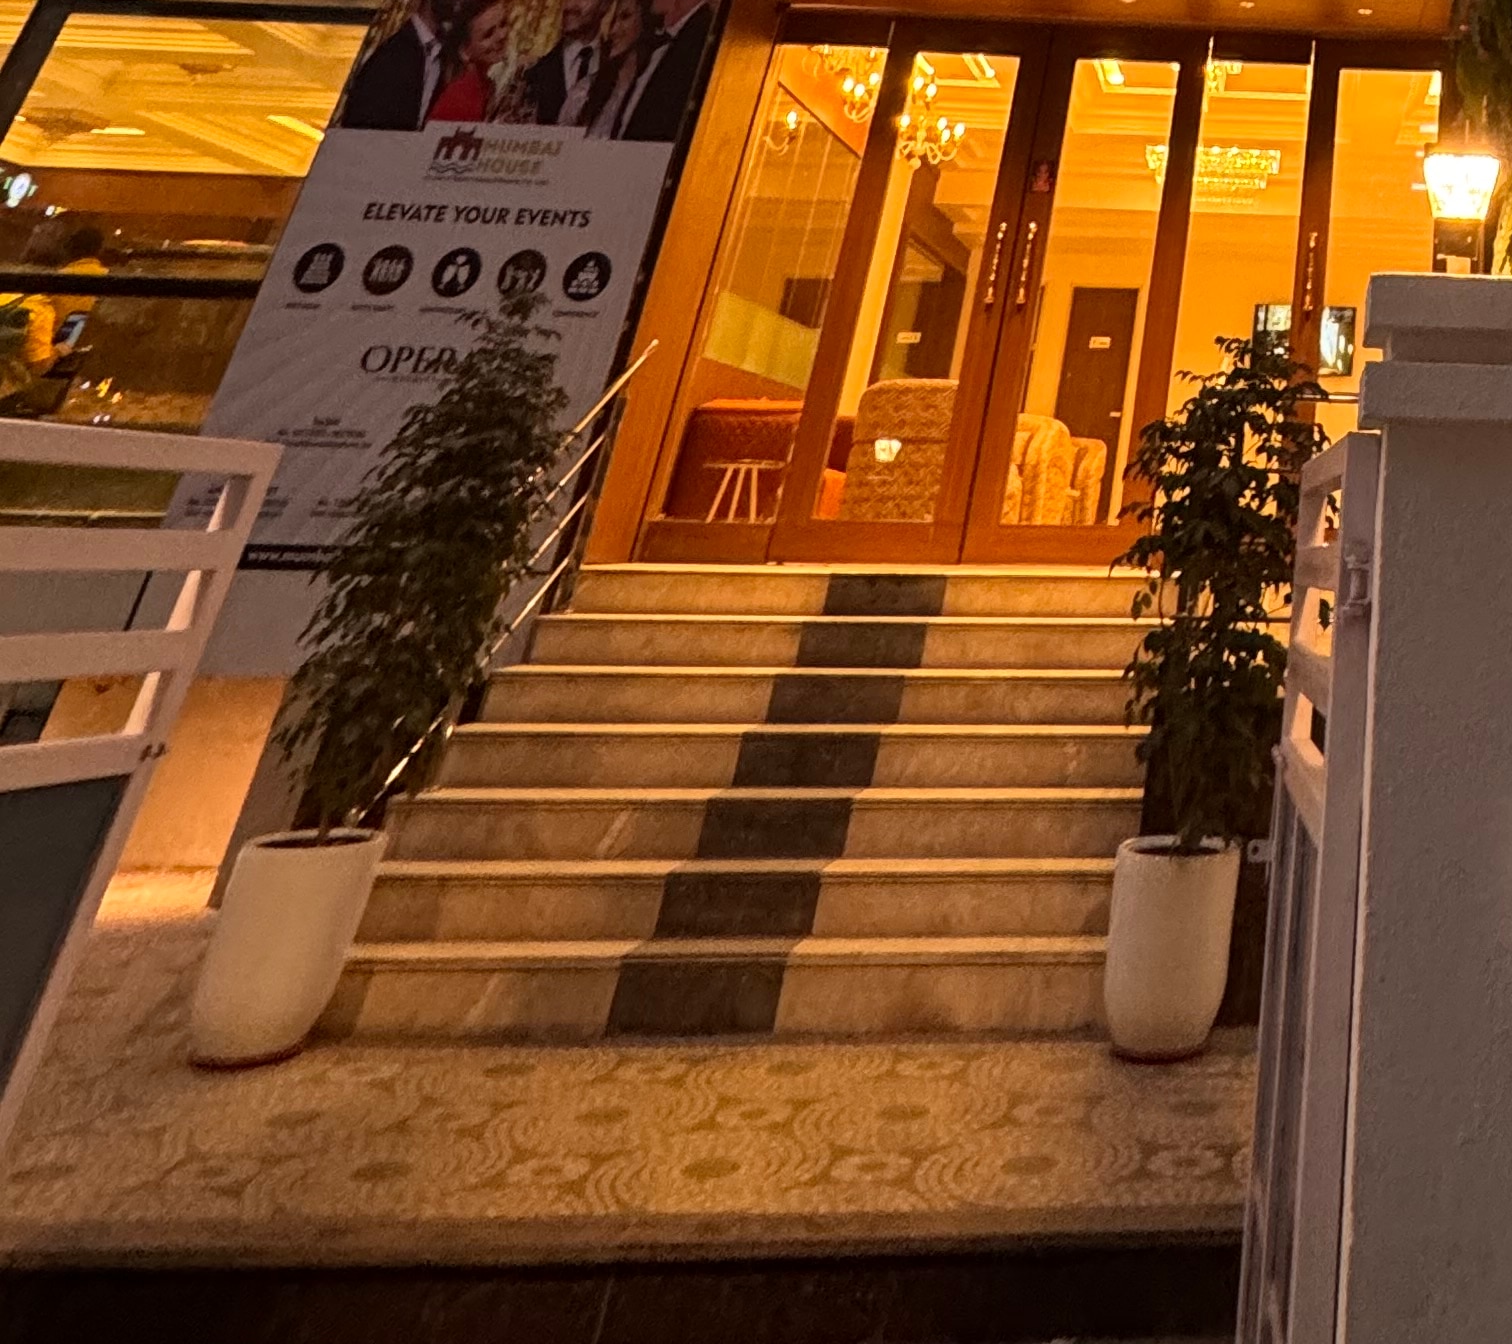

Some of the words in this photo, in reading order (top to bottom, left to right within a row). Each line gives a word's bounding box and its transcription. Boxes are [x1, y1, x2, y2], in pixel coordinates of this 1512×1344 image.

[485, 139, 562, 157] MUMBAI
[478, 158, 541, 174] HOUSE
[363, 203, 448, 222] ELEVATE
[453, 206, 509, 224] YOUR
[515, 209, 591, 228] EVENTS
